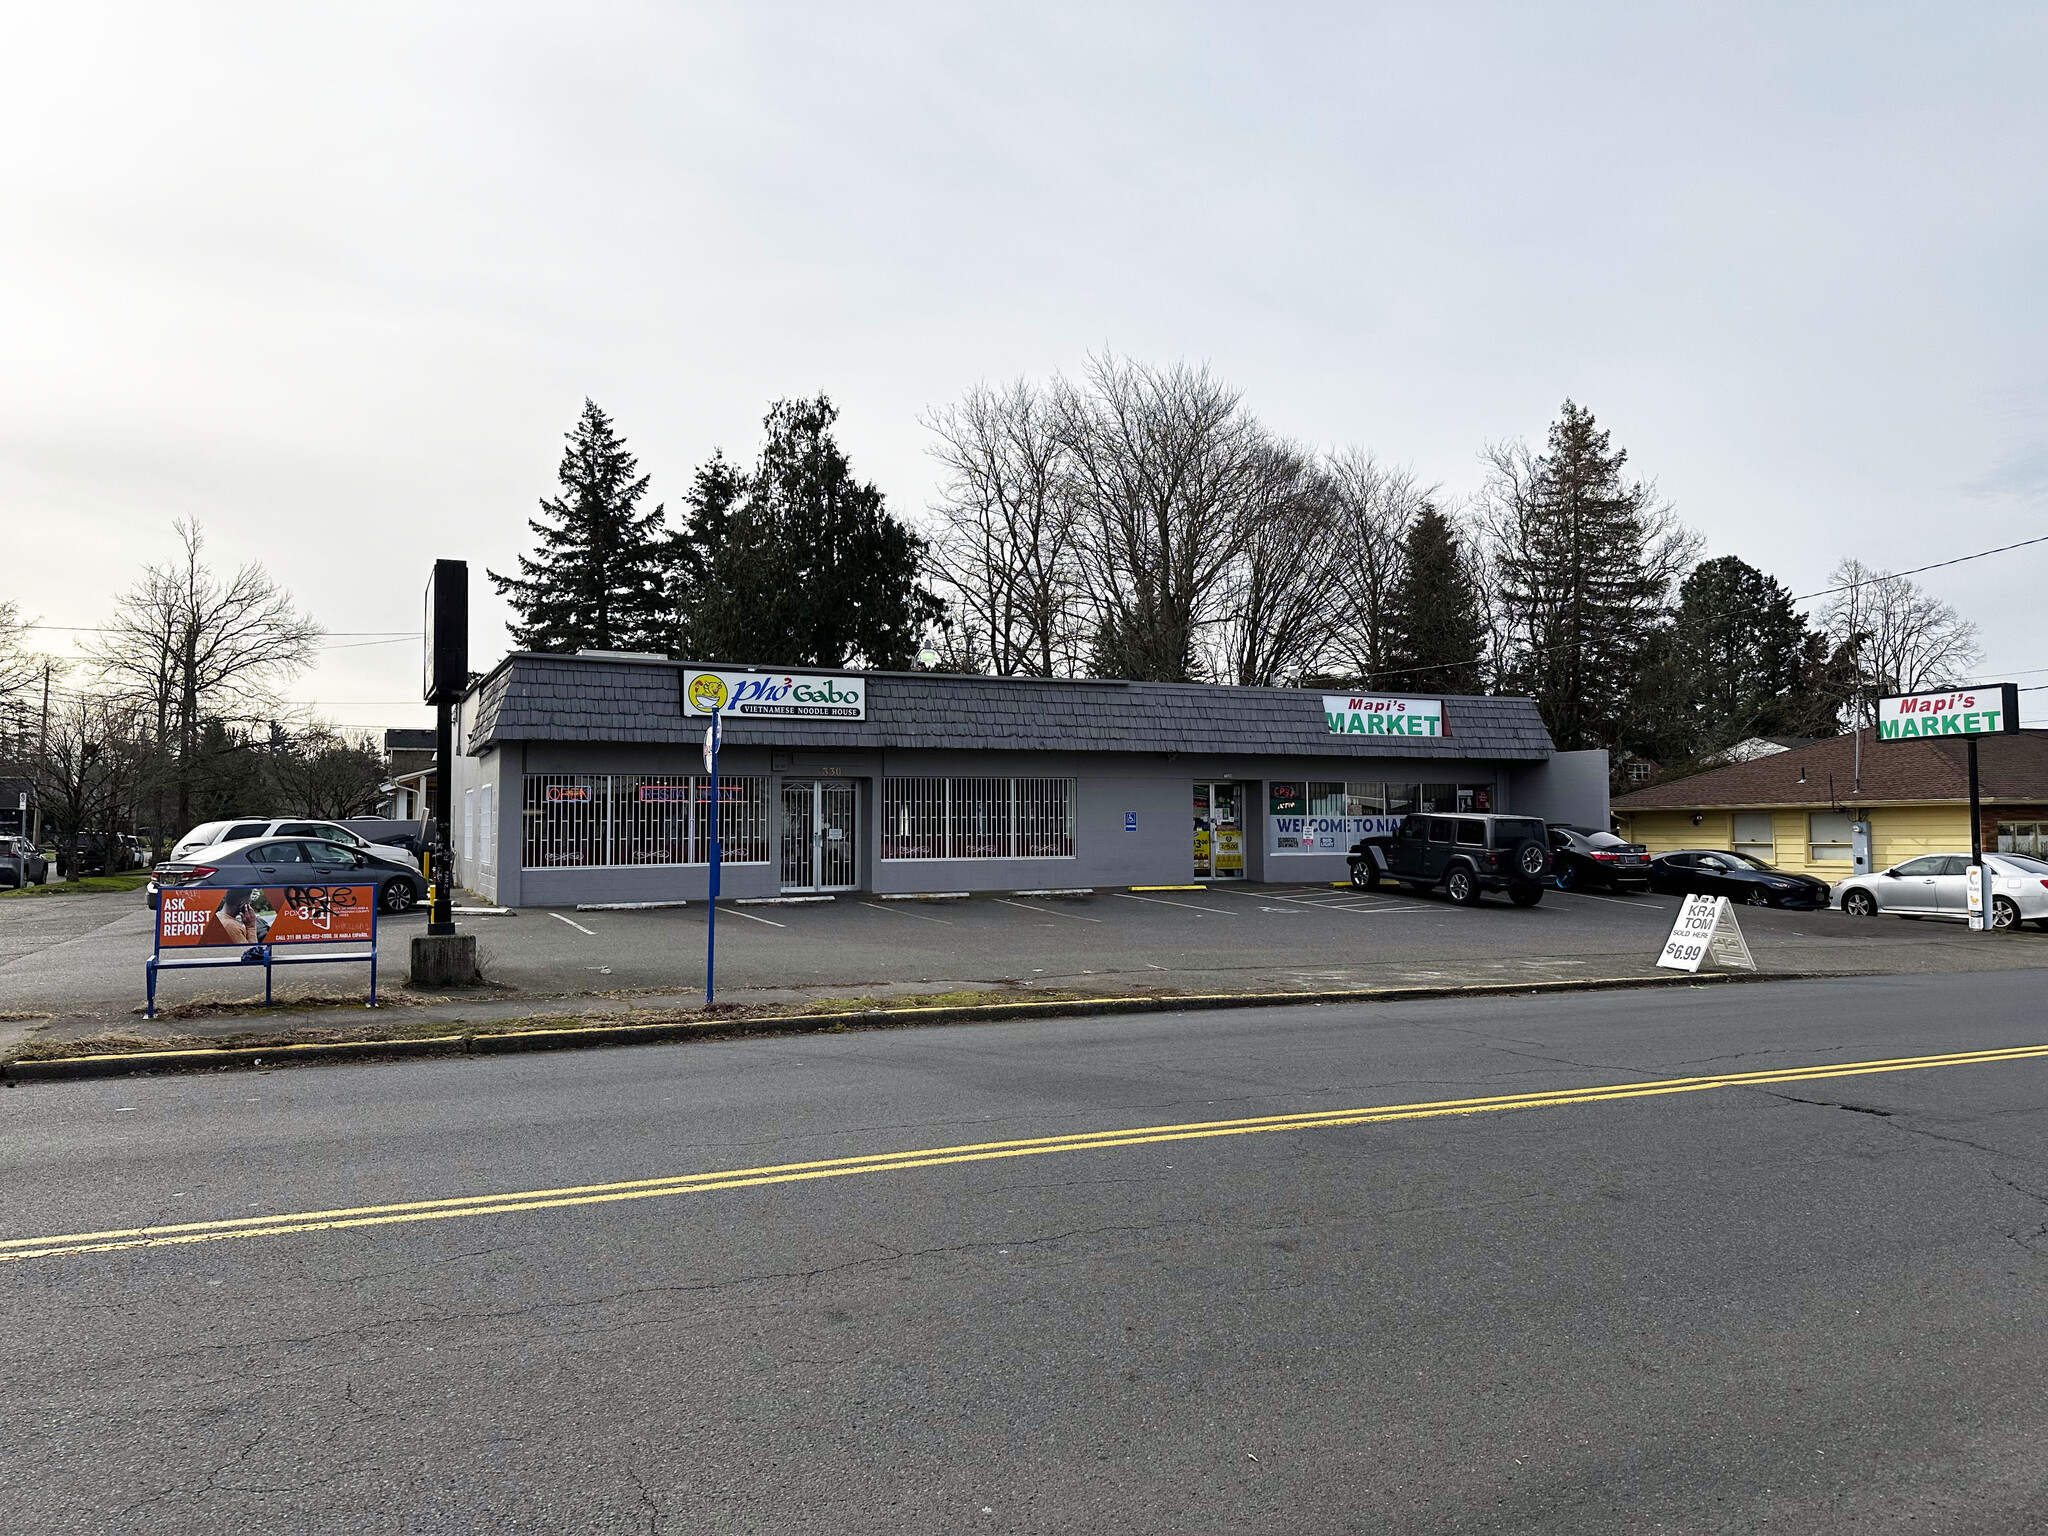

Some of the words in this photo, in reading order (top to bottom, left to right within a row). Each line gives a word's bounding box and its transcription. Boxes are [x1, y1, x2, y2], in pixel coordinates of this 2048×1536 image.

[793, 680, 859, 704] Gabo
[1348, 698, 1406, 713] Mapi's
[1899, 693, 1975, 714] Mapi's
[744, 705, 795, 714] VIETNAMESE
[797, 707, 829, 716] NOODLE
[832, 708, 858, 717] HOUSE
[1325, 712, 1441, 736] MARKET
[1880, 710, 2001, 739] MARKET
[548, 787, 589, 799] OPEN
[1353, 818, 1374, 833] TO
[164, 898, 186, 911] ASK
[1688, 905, 1715, 918] KRA
[164, 910, 212, 924] REQUEST
[1685, 918, 1713, 930] TOM
[163, 923, 206, 937] REPORT
[1666, 942, 1701, 960] $6.99
